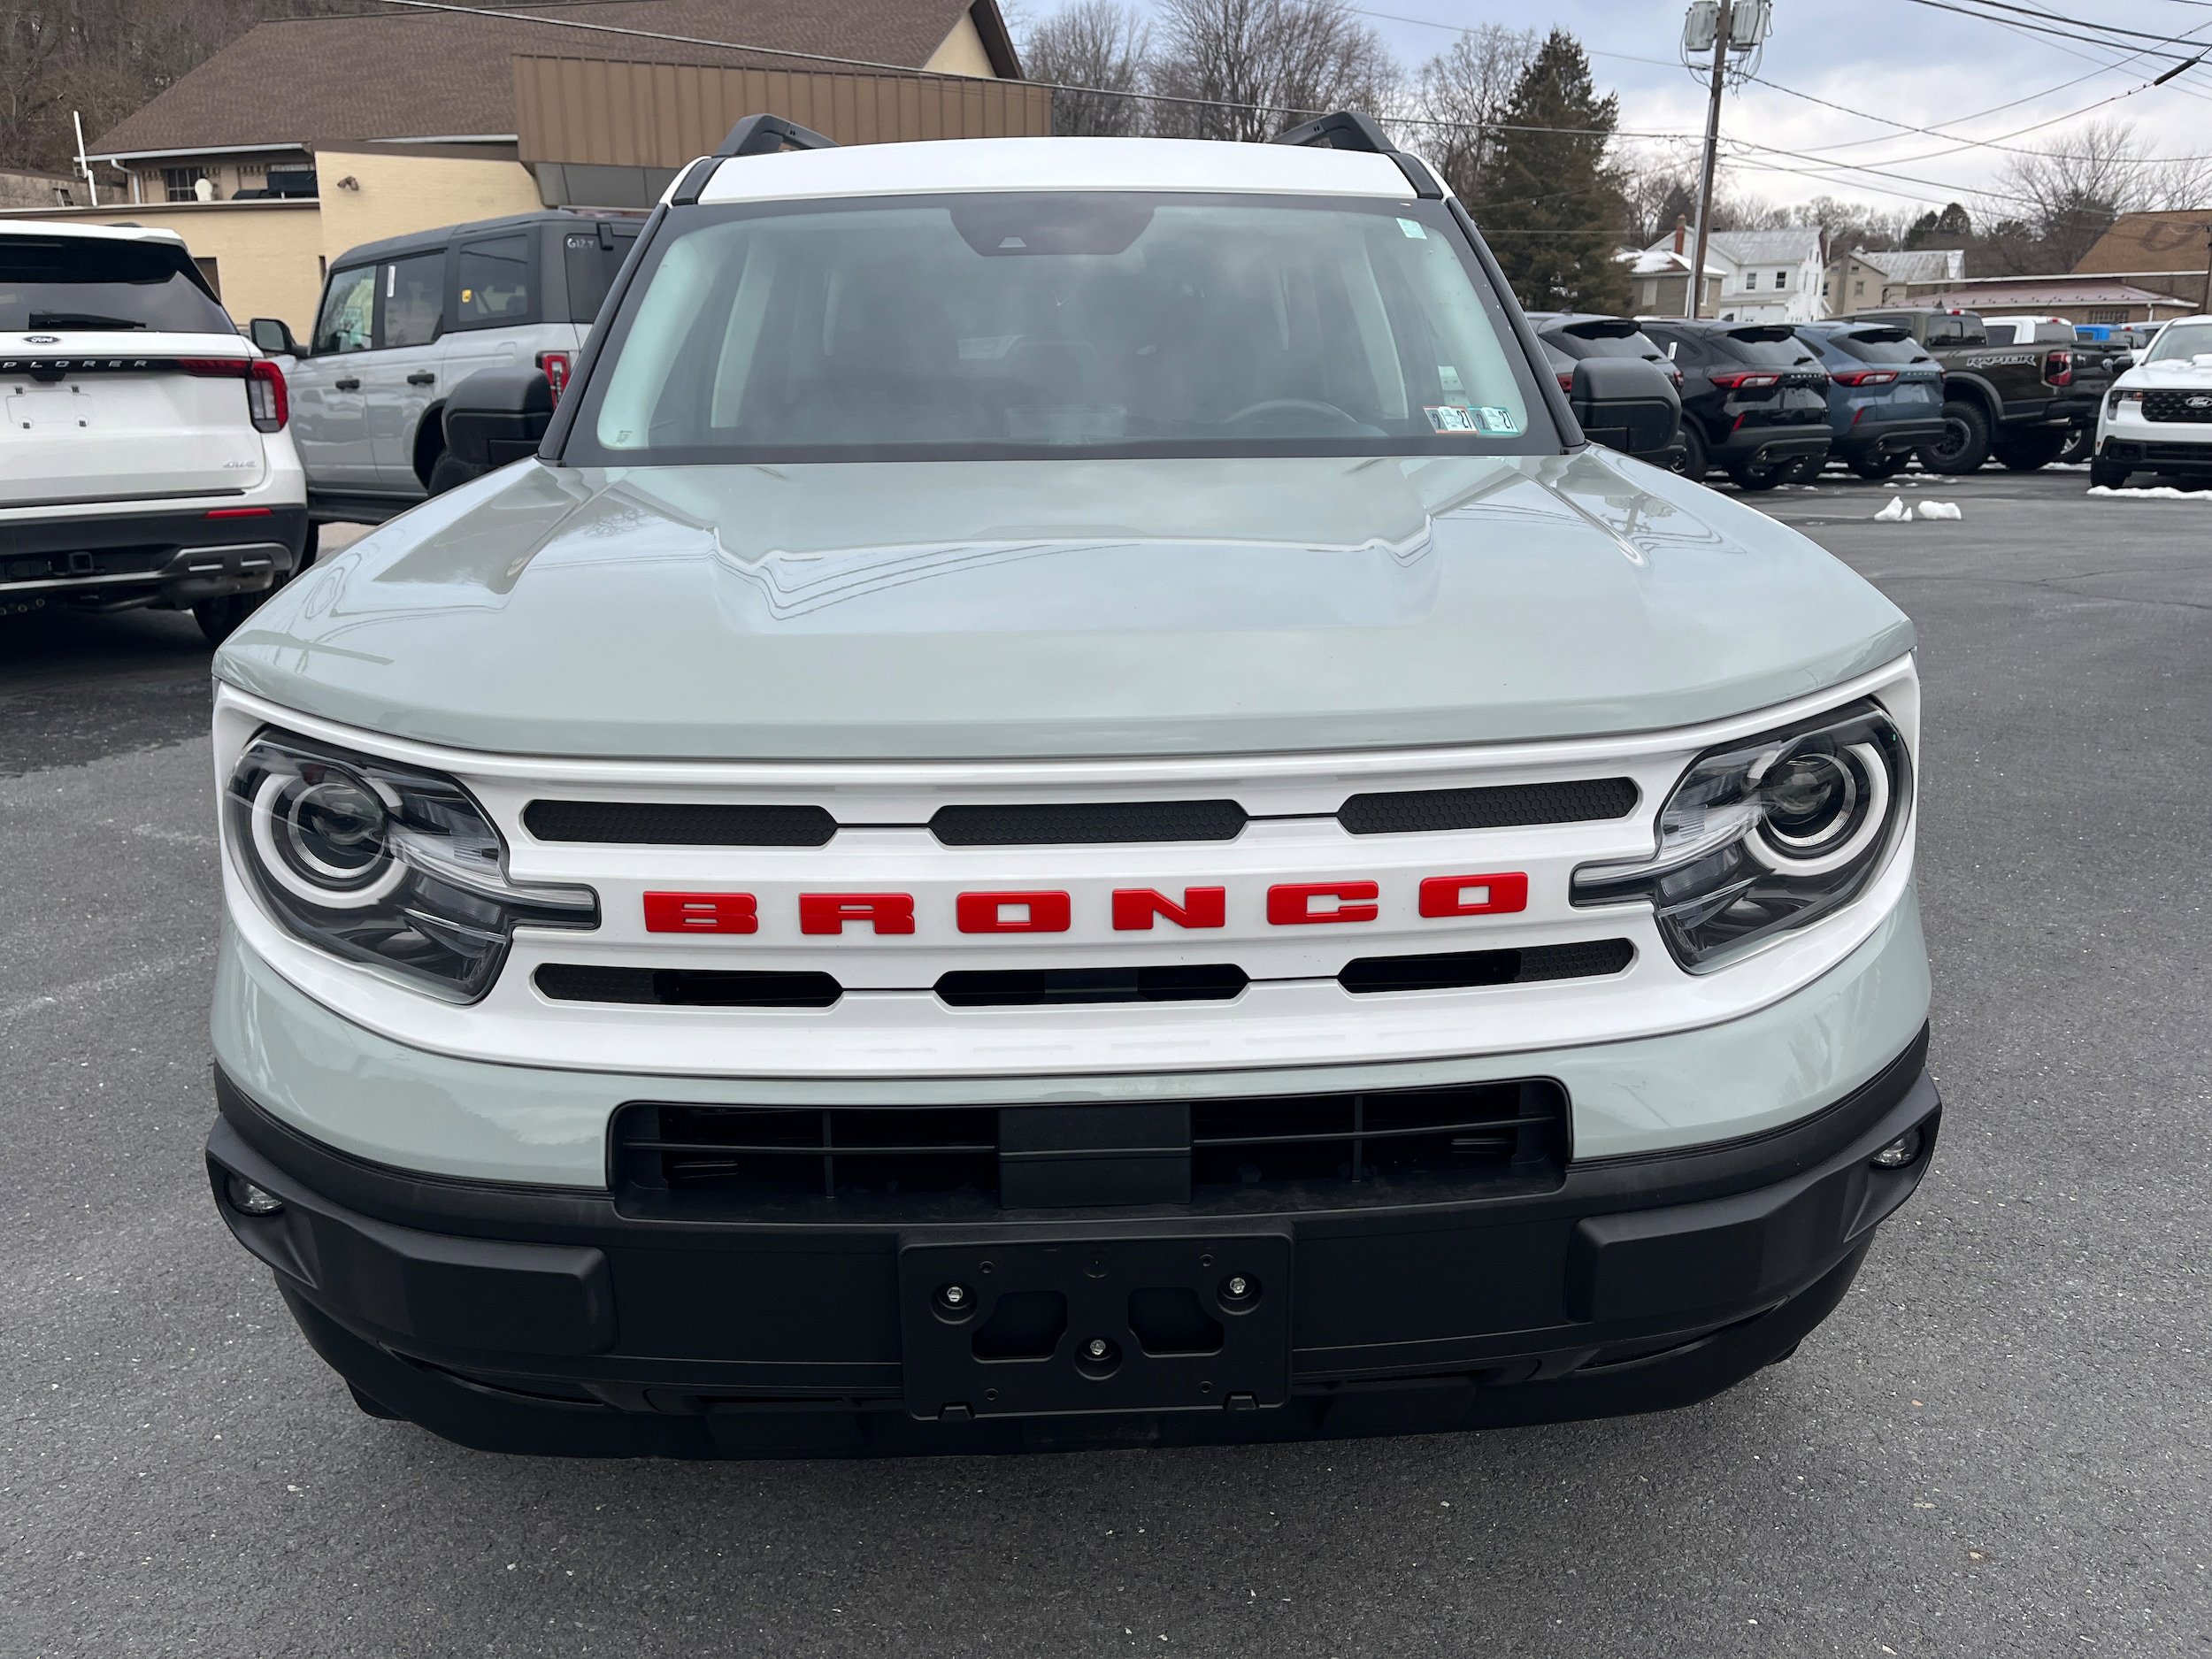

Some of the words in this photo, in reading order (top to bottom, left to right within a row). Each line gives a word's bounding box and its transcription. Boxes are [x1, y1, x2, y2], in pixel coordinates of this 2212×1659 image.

[1966, 354, 2037, 369] RAPTOR
[1456, 410, 1472, 430] 27
[1498, 411, 1514, 431] 27
[643, 872, 1528, 934] BRONCO
